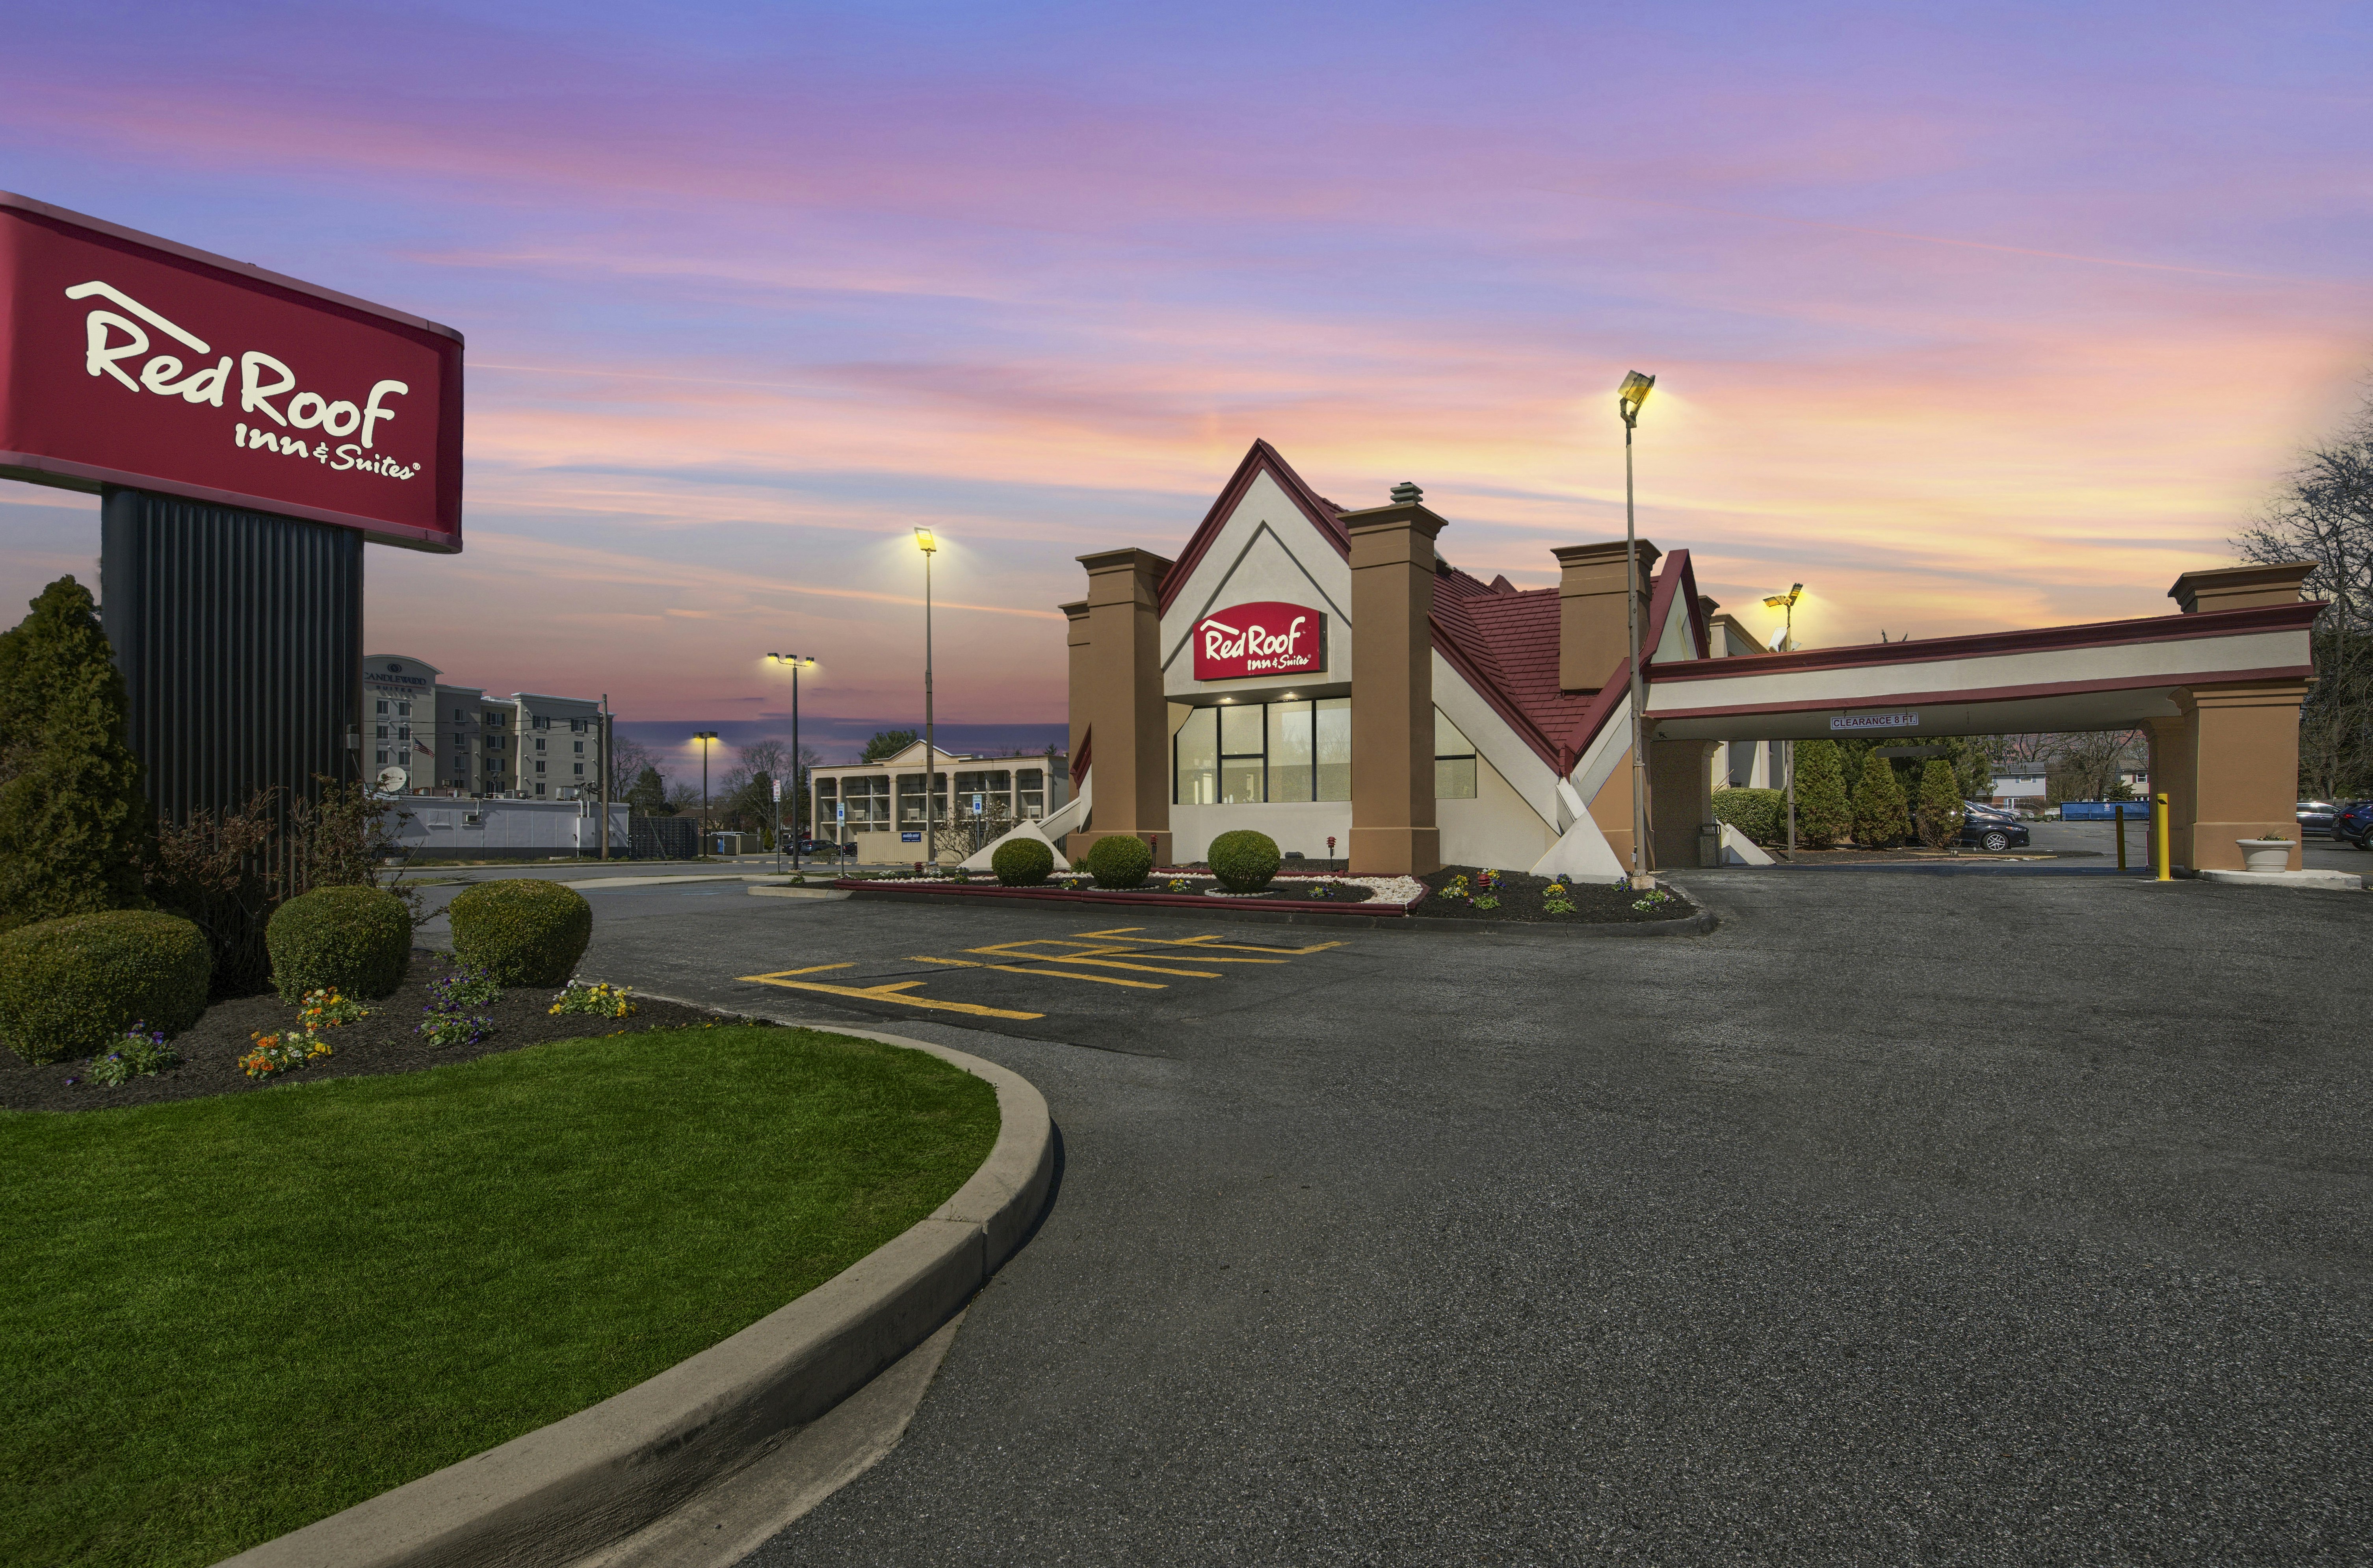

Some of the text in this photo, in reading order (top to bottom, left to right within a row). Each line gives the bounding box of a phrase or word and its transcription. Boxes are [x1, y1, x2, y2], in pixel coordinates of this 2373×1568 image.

[86, 310, 409, 449] Red Roof
[235, 423, 309, 458] Inn
[312, 442, 329, 464] &
[1206, 616, 1306, 661] Red Roof
[1247, 659, 1271, 671] Inn
[1272, 657, 1278, 668] &
[1833, 716, 1892, 727] CLEARANCE
[735, 927, 1351, 1020] FIRE
